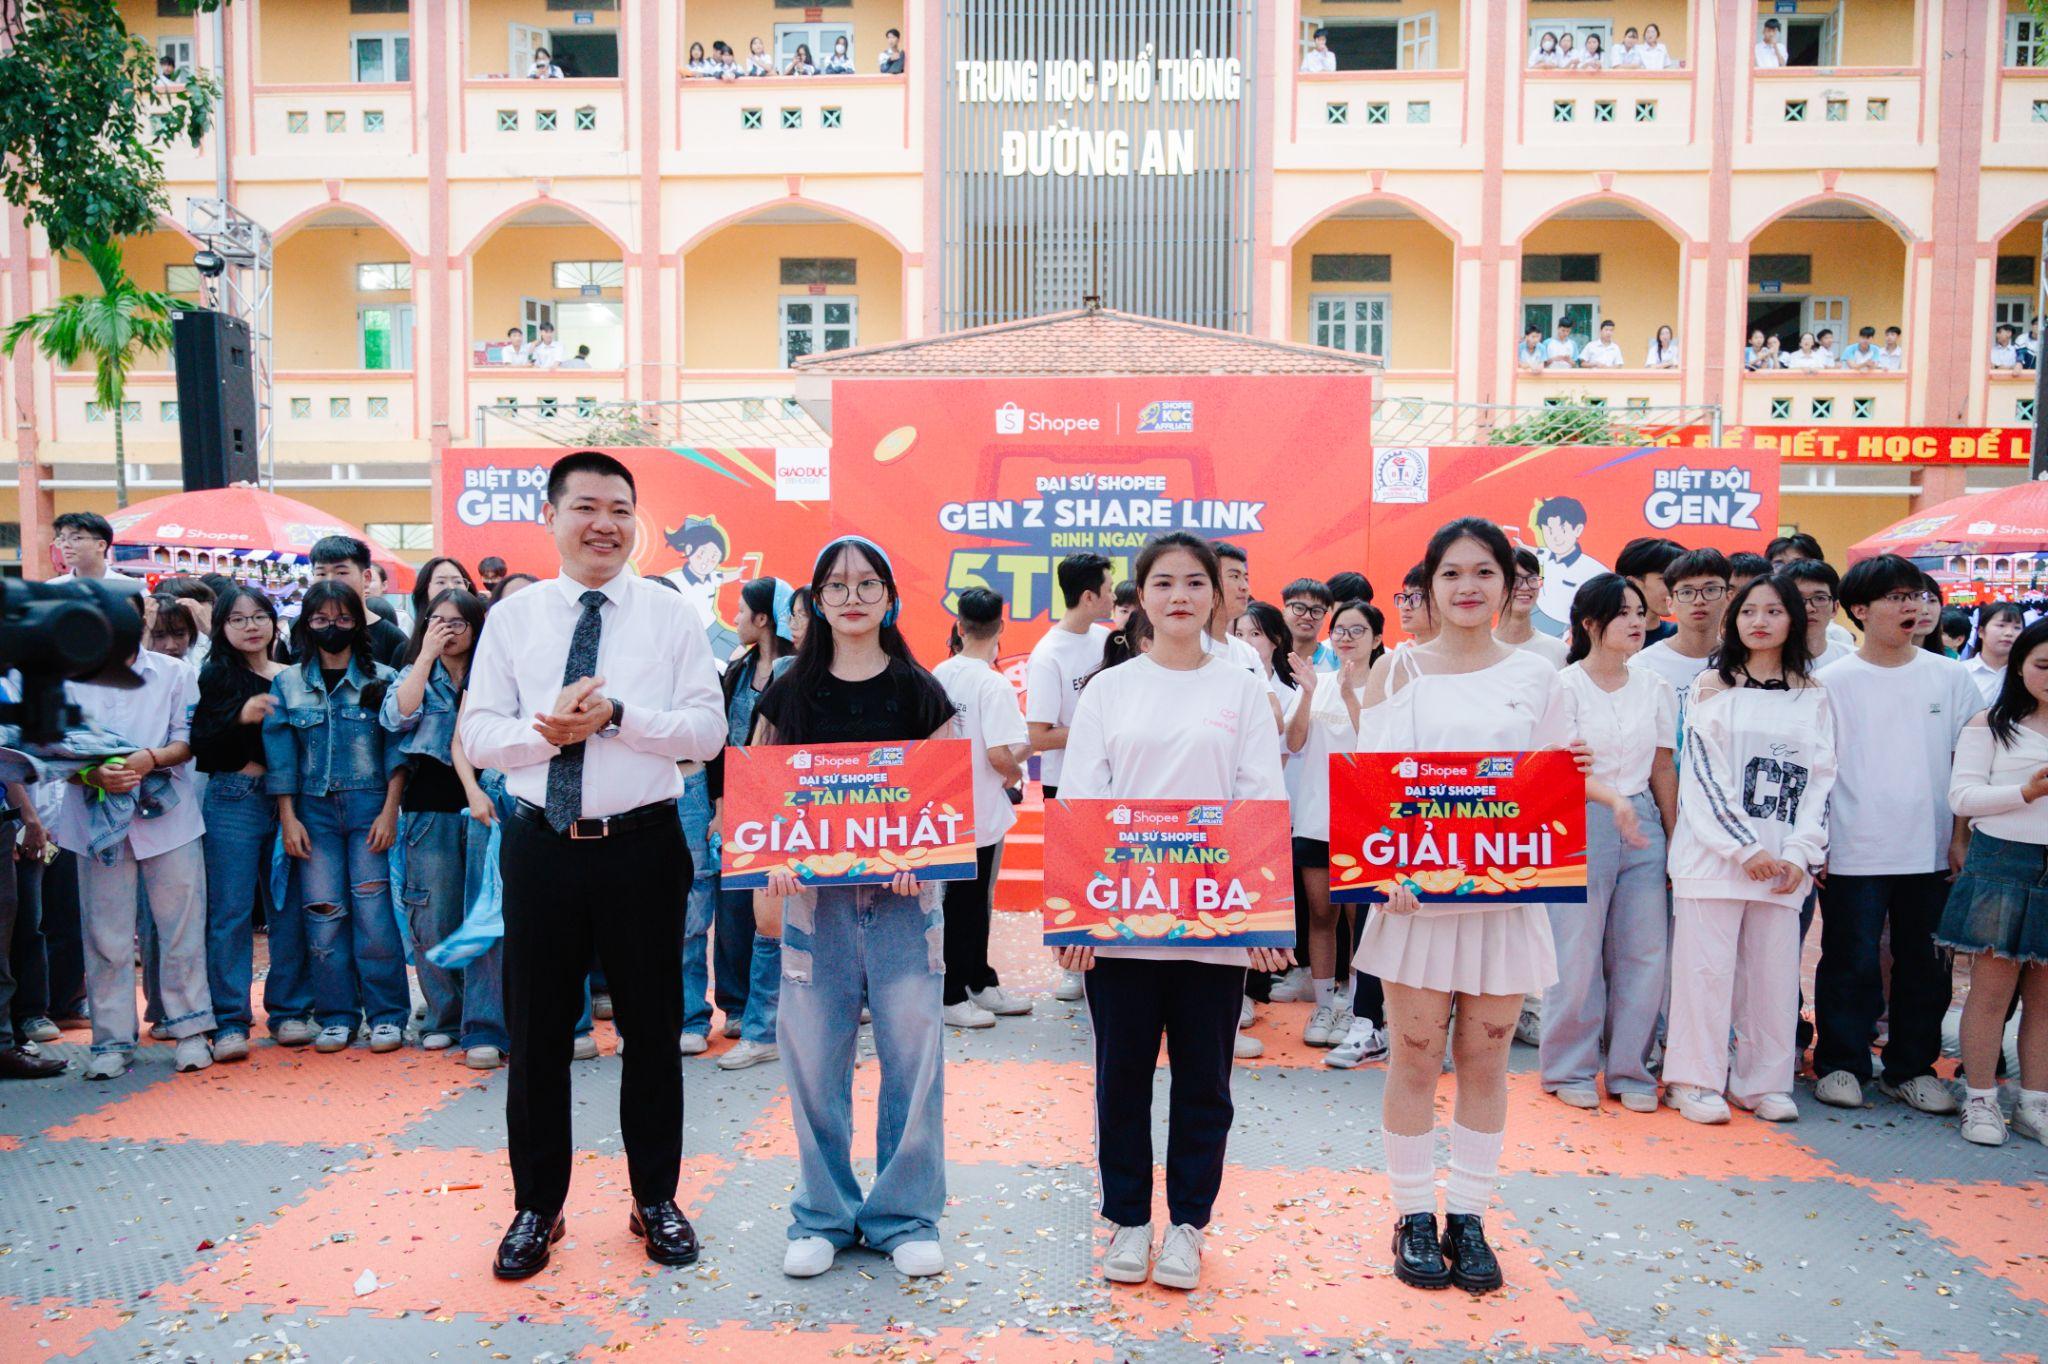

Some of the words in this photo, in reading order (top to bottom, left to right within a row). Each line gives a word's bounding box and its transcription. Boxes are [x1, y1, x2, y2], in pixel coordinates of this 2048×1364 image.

[955, 60, 1038, 103] TRUNG
[1044, 59, 1094, 110] HỌC
[1101, 43, 1154, 103] PHỔ
[1157, 49, 1241, 102] THÔNG
[1001, 119, 1129, 177] ĐƯỜNG
[1140, 129, 1194, 176] AN
[1028, 412, 1100, 436] Shopee
[1858, 435, 1938, 461] HỌC
[1949, 428, 2003, 458] ĐỂ
[465, 465, 511, 490] BIỆT
[1036, 476, 1066, 493] ĐẠI
[1070, 473, 1095, 491] SỨ
[1098, 476, 1167, 491] SHOPEE
[1655, 465, 1705, 492] BIỆT
[1710, 465, 1751, 492] ĐỘI
[457, 489, 546, 526] GEN
[939, 501, 1012, 531] GEN
[1022, 500, 1045, 528] Z
[1054, 499, 1172, 528] SHARE
[1182, 501, 1264, 531] LINK
[187, 529, 249, 542] Shopee
[1051, 532, 1093, 547] RINH
[1099, 532, 1148, 547] NGAY
[1999, 525, 2048, 537] Shop
[814, 755, 860, 768] Shopee
[1420, 764, 1468, 778] Shopee
[799, 776, 820, 786] ĐẠI
[841, 773, 888, 783] SHOPEE
[811, 786, 844, 806] TÀI
[849, 785, 911, 804] NĂNG
[1405, 786, 1426, 798] ĐẠI
[1448, 785, 1496, 795] SHOPEE
[1743, 757, 1808, 825] CR
[1133, 811, 1179, 825] Shopee
[1417, 799, 1450, 818] TÀI
[1457, 798, 1520, 818] NĂNG
[734, 808, 829, 852] GIẢI
[846, 801, 963, 849] NHẤT
[1119, 832, 1138, 843] ĐẠI
[1161, 832, 1207, 842] SHOPEE
[1362, 820, 1458, 866] GIẢI
[1475, 823, 1552, 865] NHÌ
[1130, 844, 1163, 863] TÀI
[1169, 844, 1230, 864] NĂNG
[1086, 867, 1179, 910] GIẢI
[1196, 878, 1252, 910] BA
